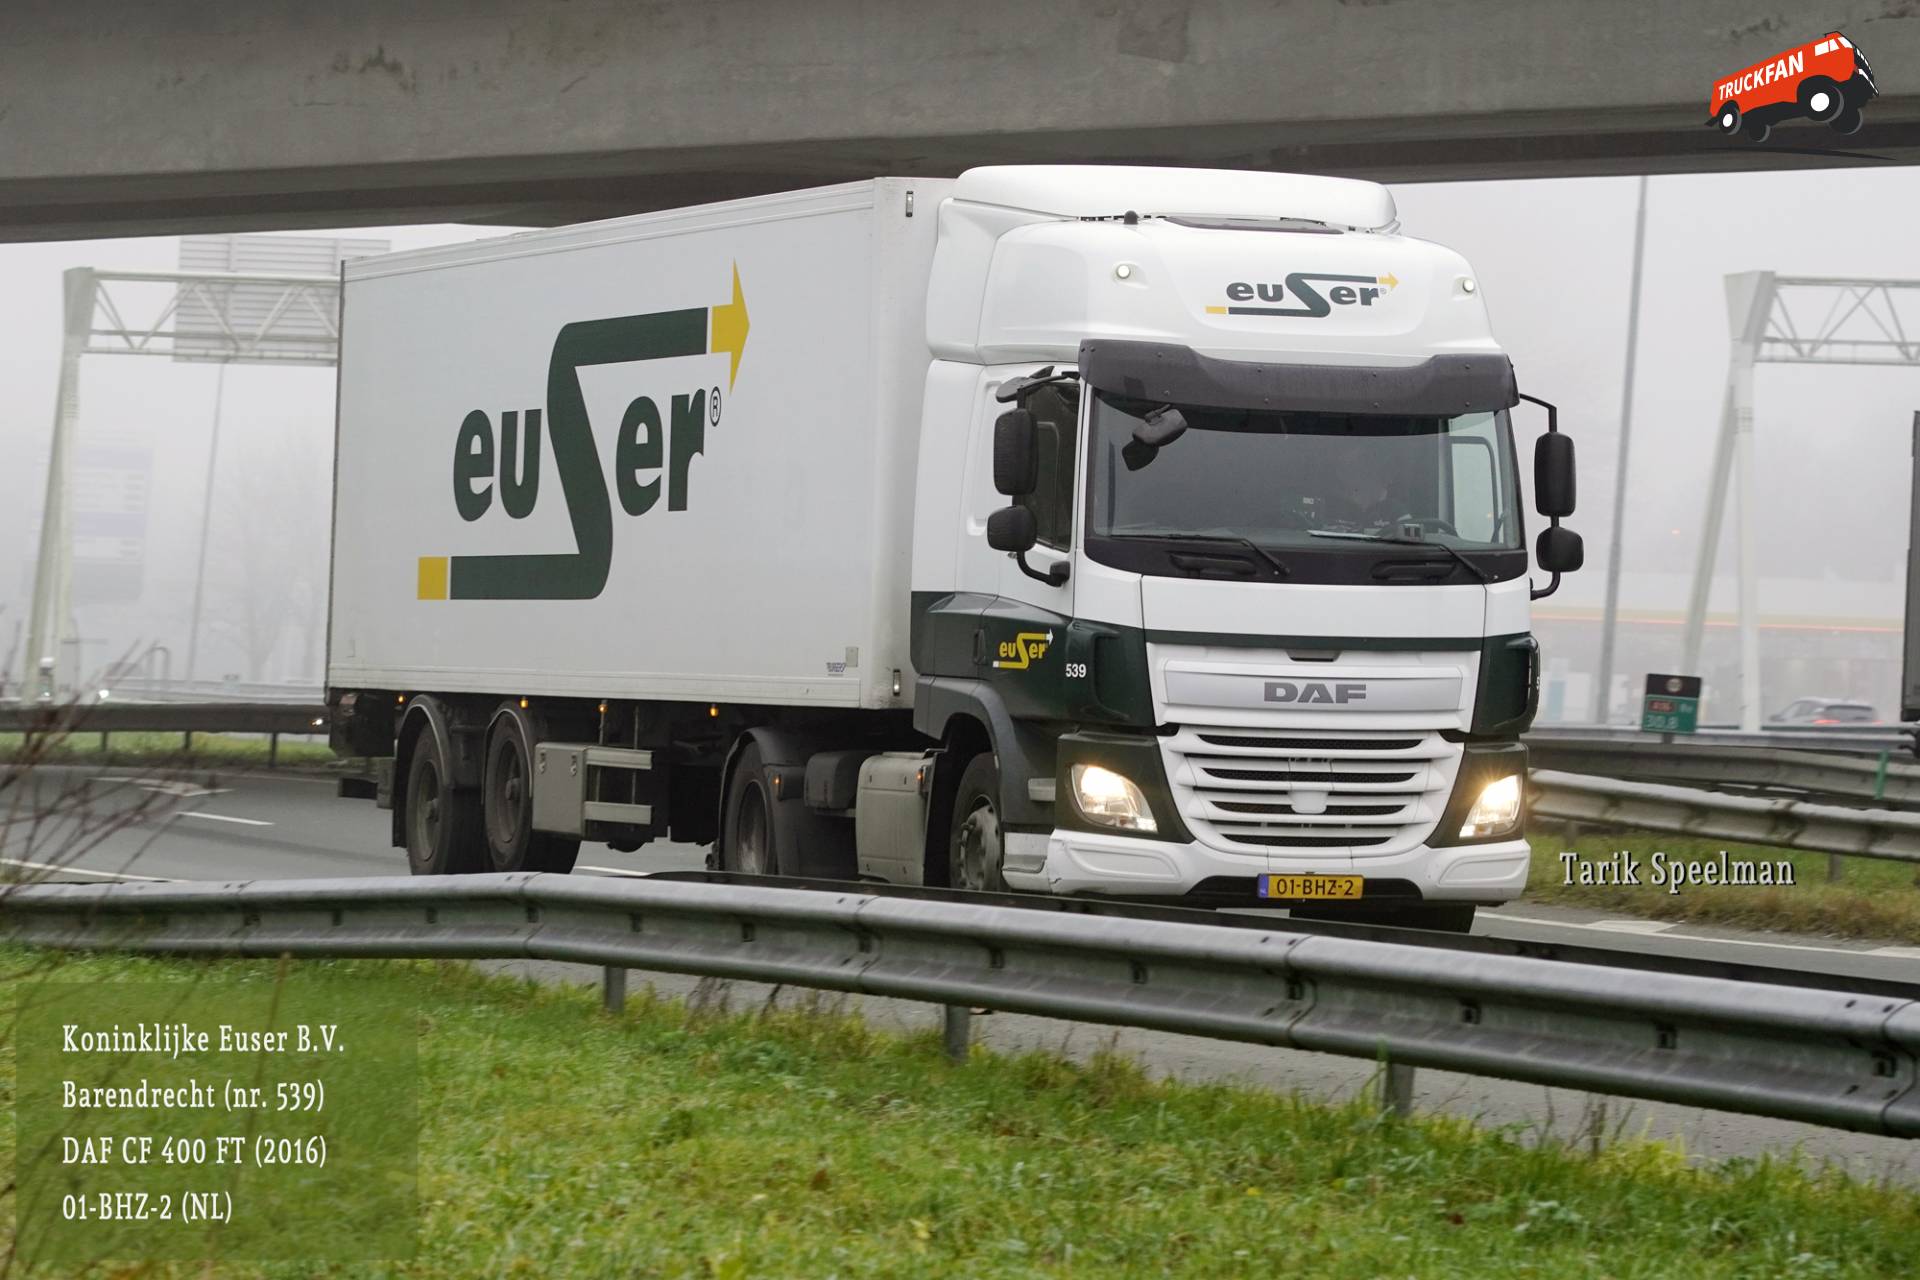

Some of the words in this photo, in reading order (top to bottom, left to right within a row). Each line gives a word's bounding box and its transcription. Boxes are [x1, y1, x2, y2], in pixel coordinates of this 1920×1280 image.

[1065, 663, 1087, 678] 539
[1264, 682, 1366, 704] DAF
[1276, 878, 1354, 896] 01-BHZ-2
